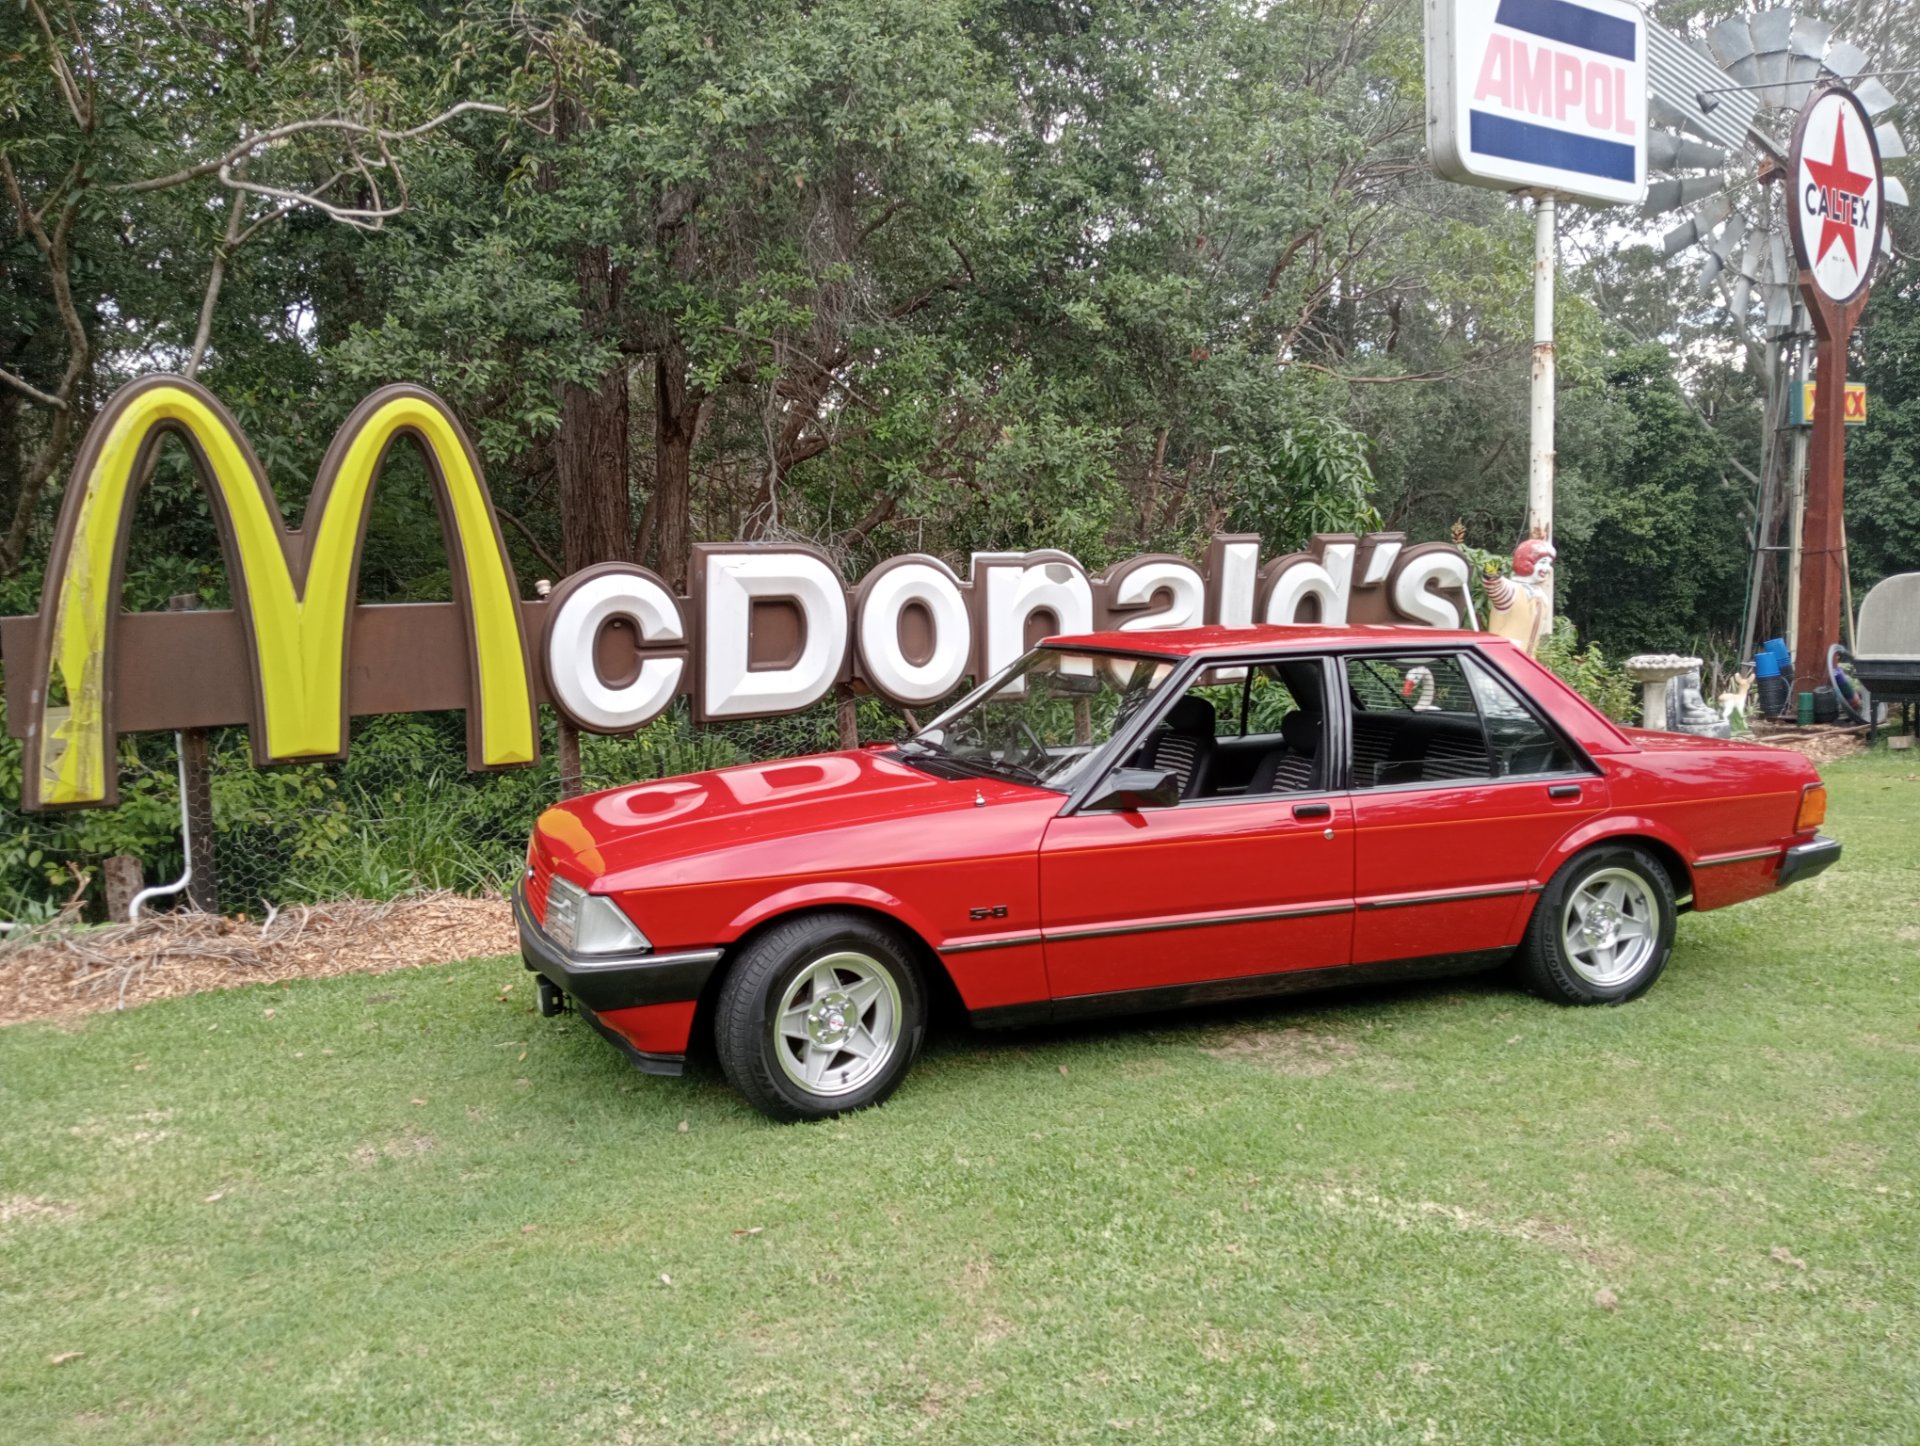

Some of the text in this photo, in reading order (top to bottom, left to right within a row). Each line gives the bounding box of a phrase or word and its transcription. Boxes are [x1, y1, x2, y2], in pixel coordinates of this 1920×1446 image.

[1474, 32, 1637, 137] AMPOL
[1805, 182, 1870, 230] CALTEX
[38, 386, 1471, 805] McDonald's
